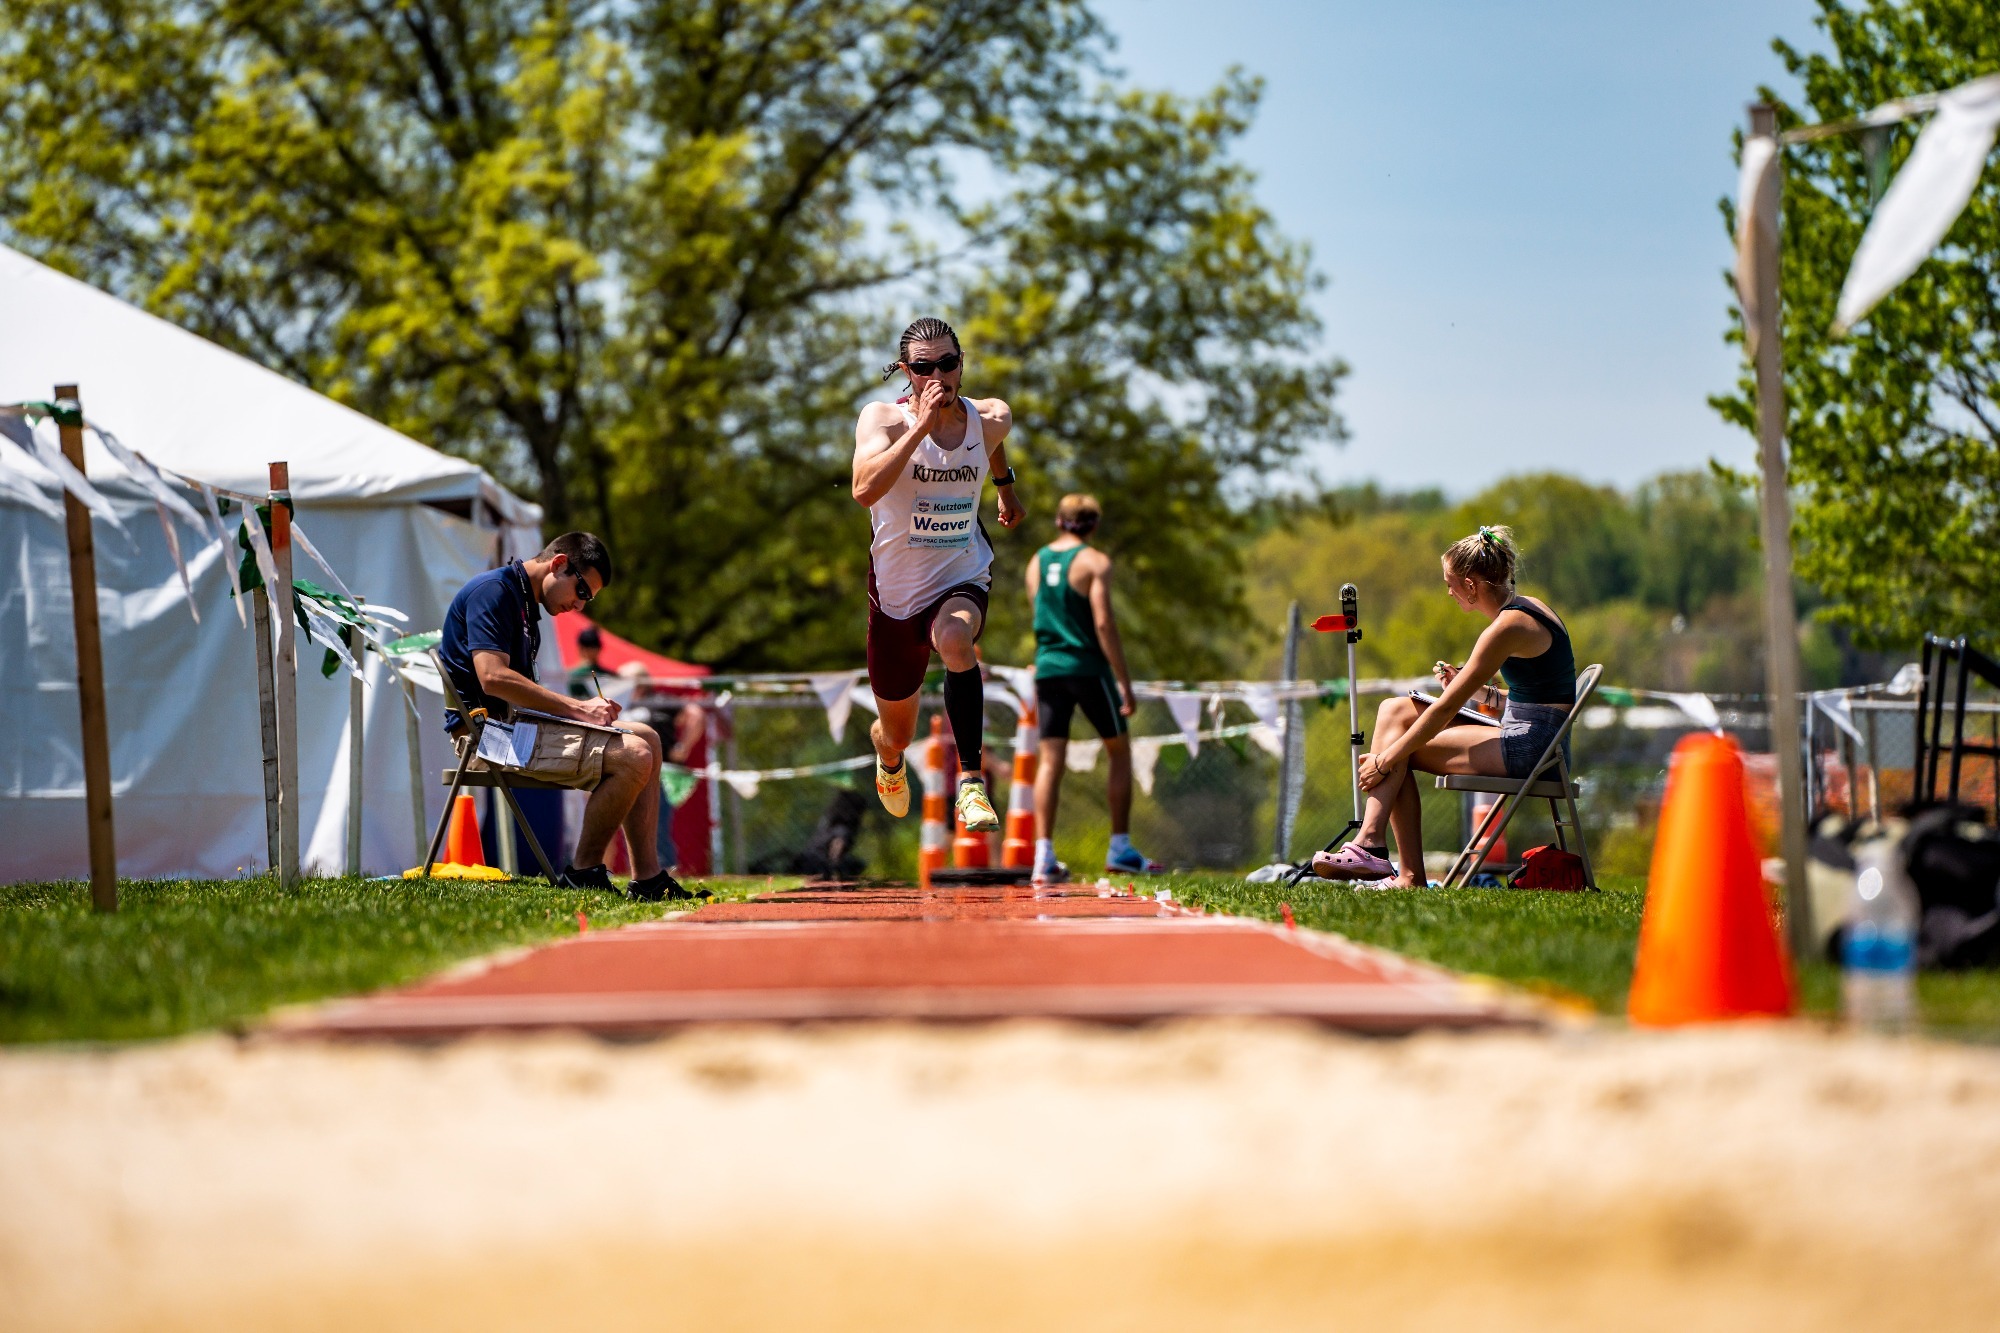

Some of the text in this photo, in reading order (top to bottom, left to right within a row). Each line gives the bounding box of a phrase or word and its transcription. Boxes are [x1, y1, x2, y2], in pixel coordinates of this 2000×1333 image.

[912, 464, 980, 482] KUTZTOWN
[933, 502, 972, 511] Kutztown
[913, 516, 970, 531] Weaver
